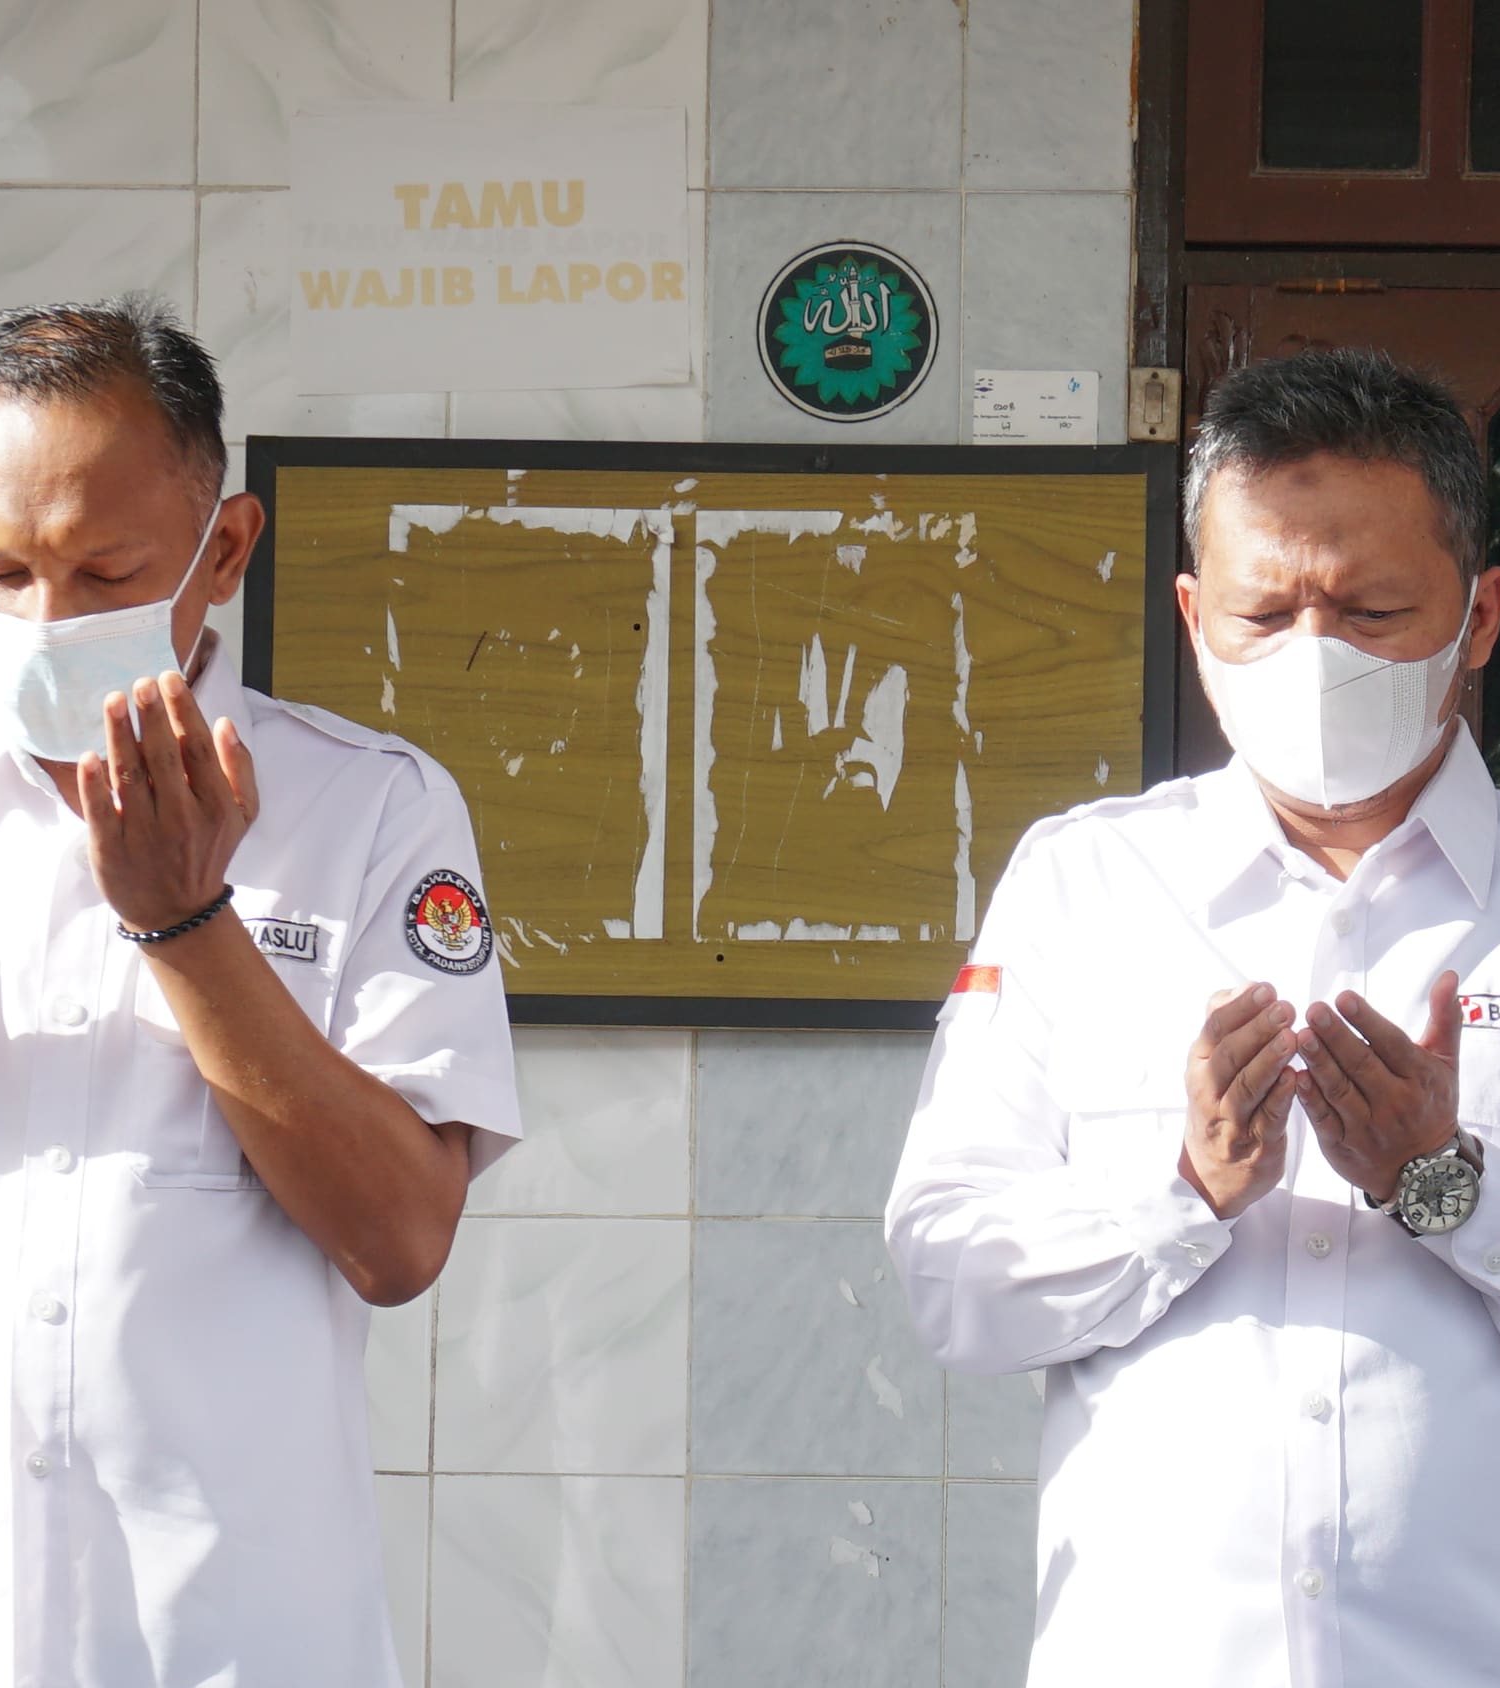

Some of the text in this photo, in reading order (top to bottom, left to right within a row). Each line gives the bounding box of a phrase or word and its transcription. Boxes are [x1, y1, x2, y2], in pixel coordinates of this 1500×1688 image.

[393, 179, 586, 230] TAMU
[299, 261, 687, 310] WAJIB LAPOR
[250, 922, 309, 951] ASLU
